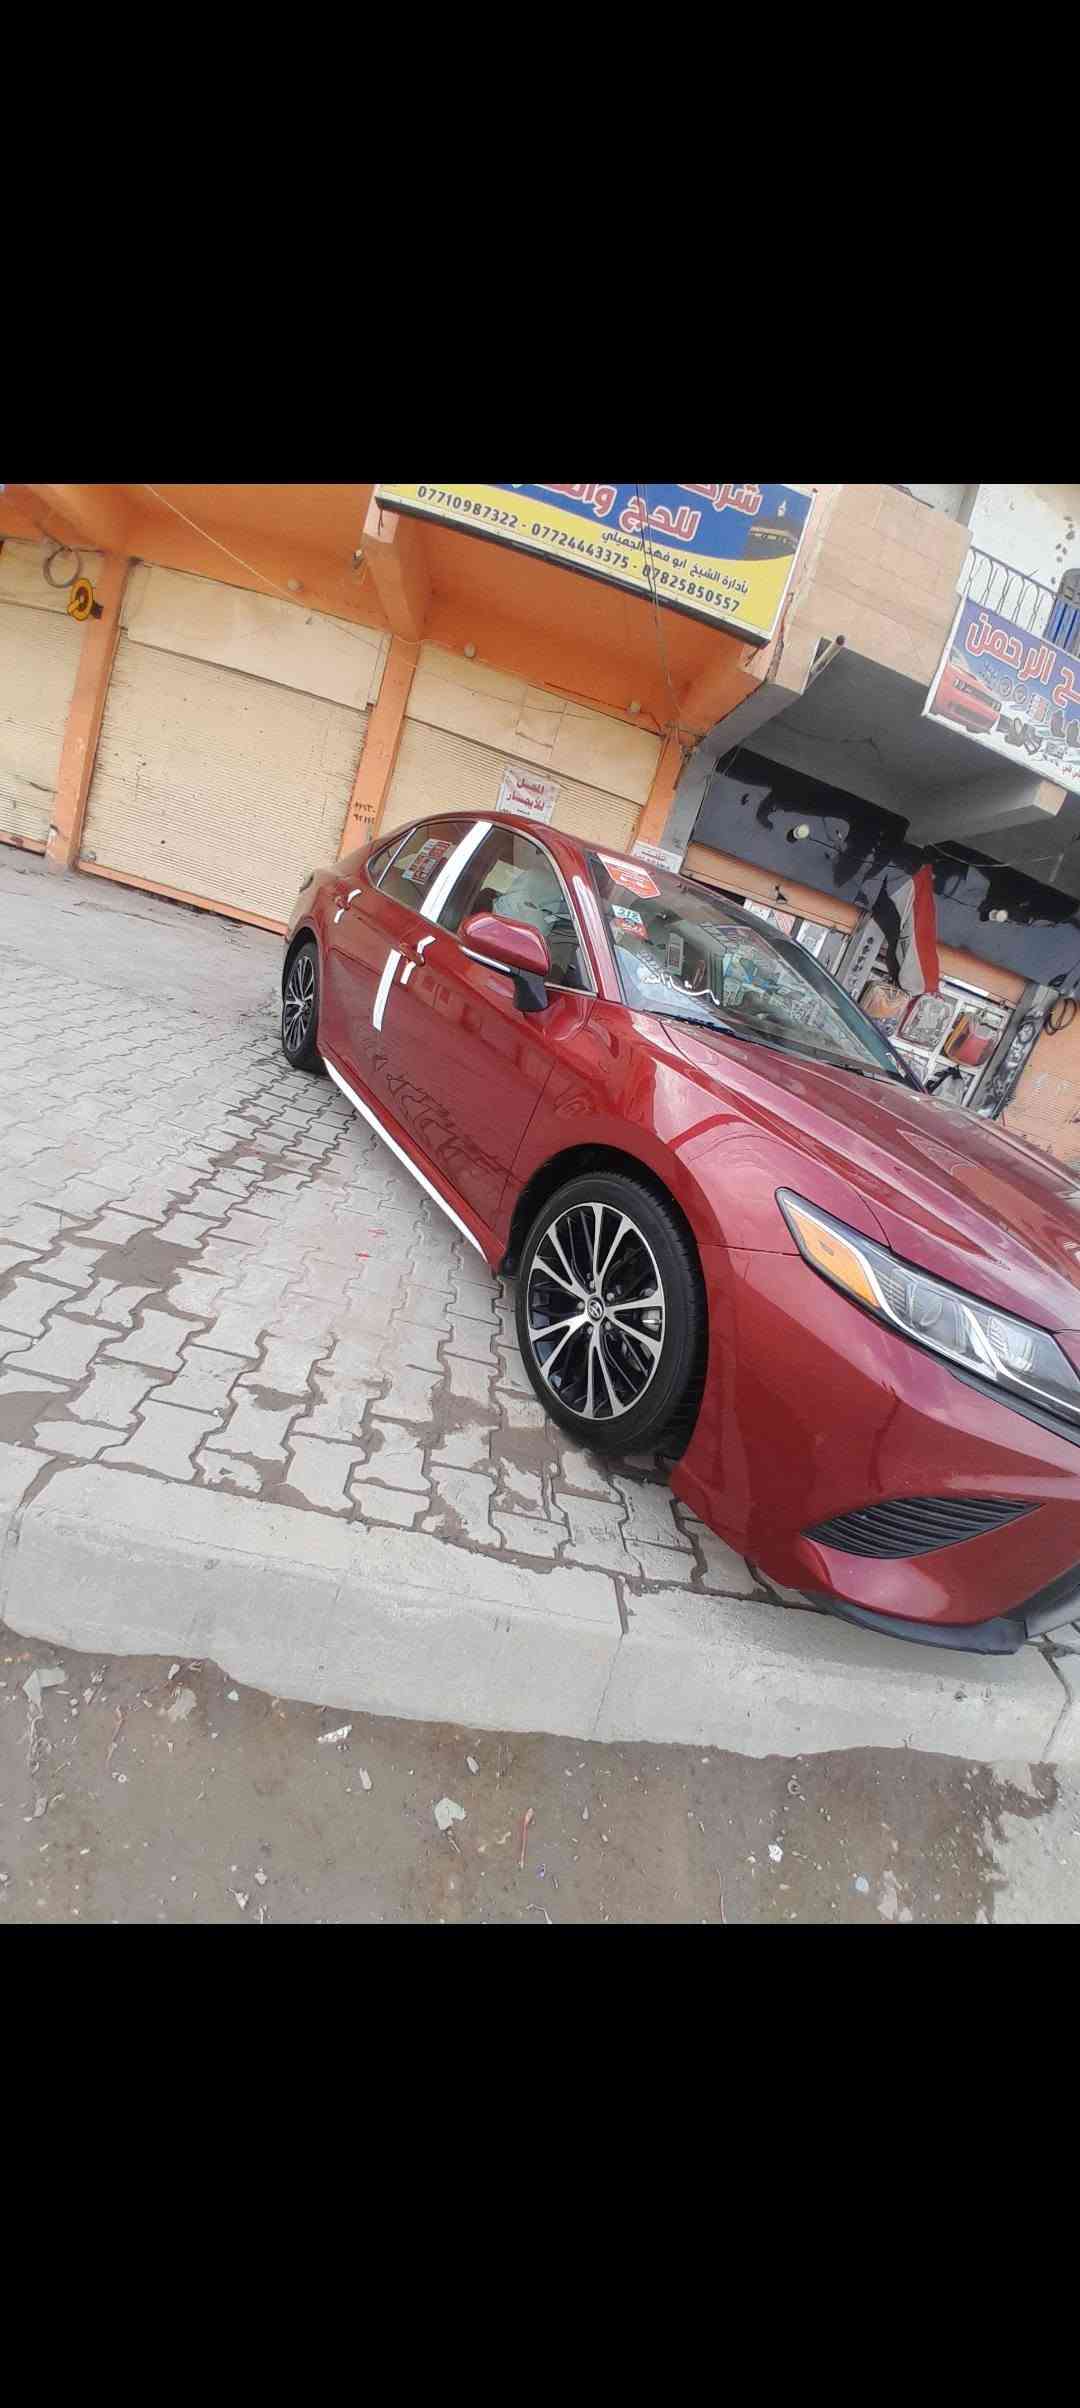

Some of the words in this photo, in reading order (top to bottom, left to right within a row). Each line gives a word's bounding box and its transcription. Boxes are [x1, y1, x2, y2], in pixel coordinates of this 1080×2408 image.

[417, 485, 518, 528] 07710987322
[531, 522, 630, 569] 07724443375
[641, 563, 740, 612] 07825850557
[619, 496, 701, 541] للحج
[689, 563, 721, 582] الشيخ
[964, 611, 1057, 686] الرحمن
